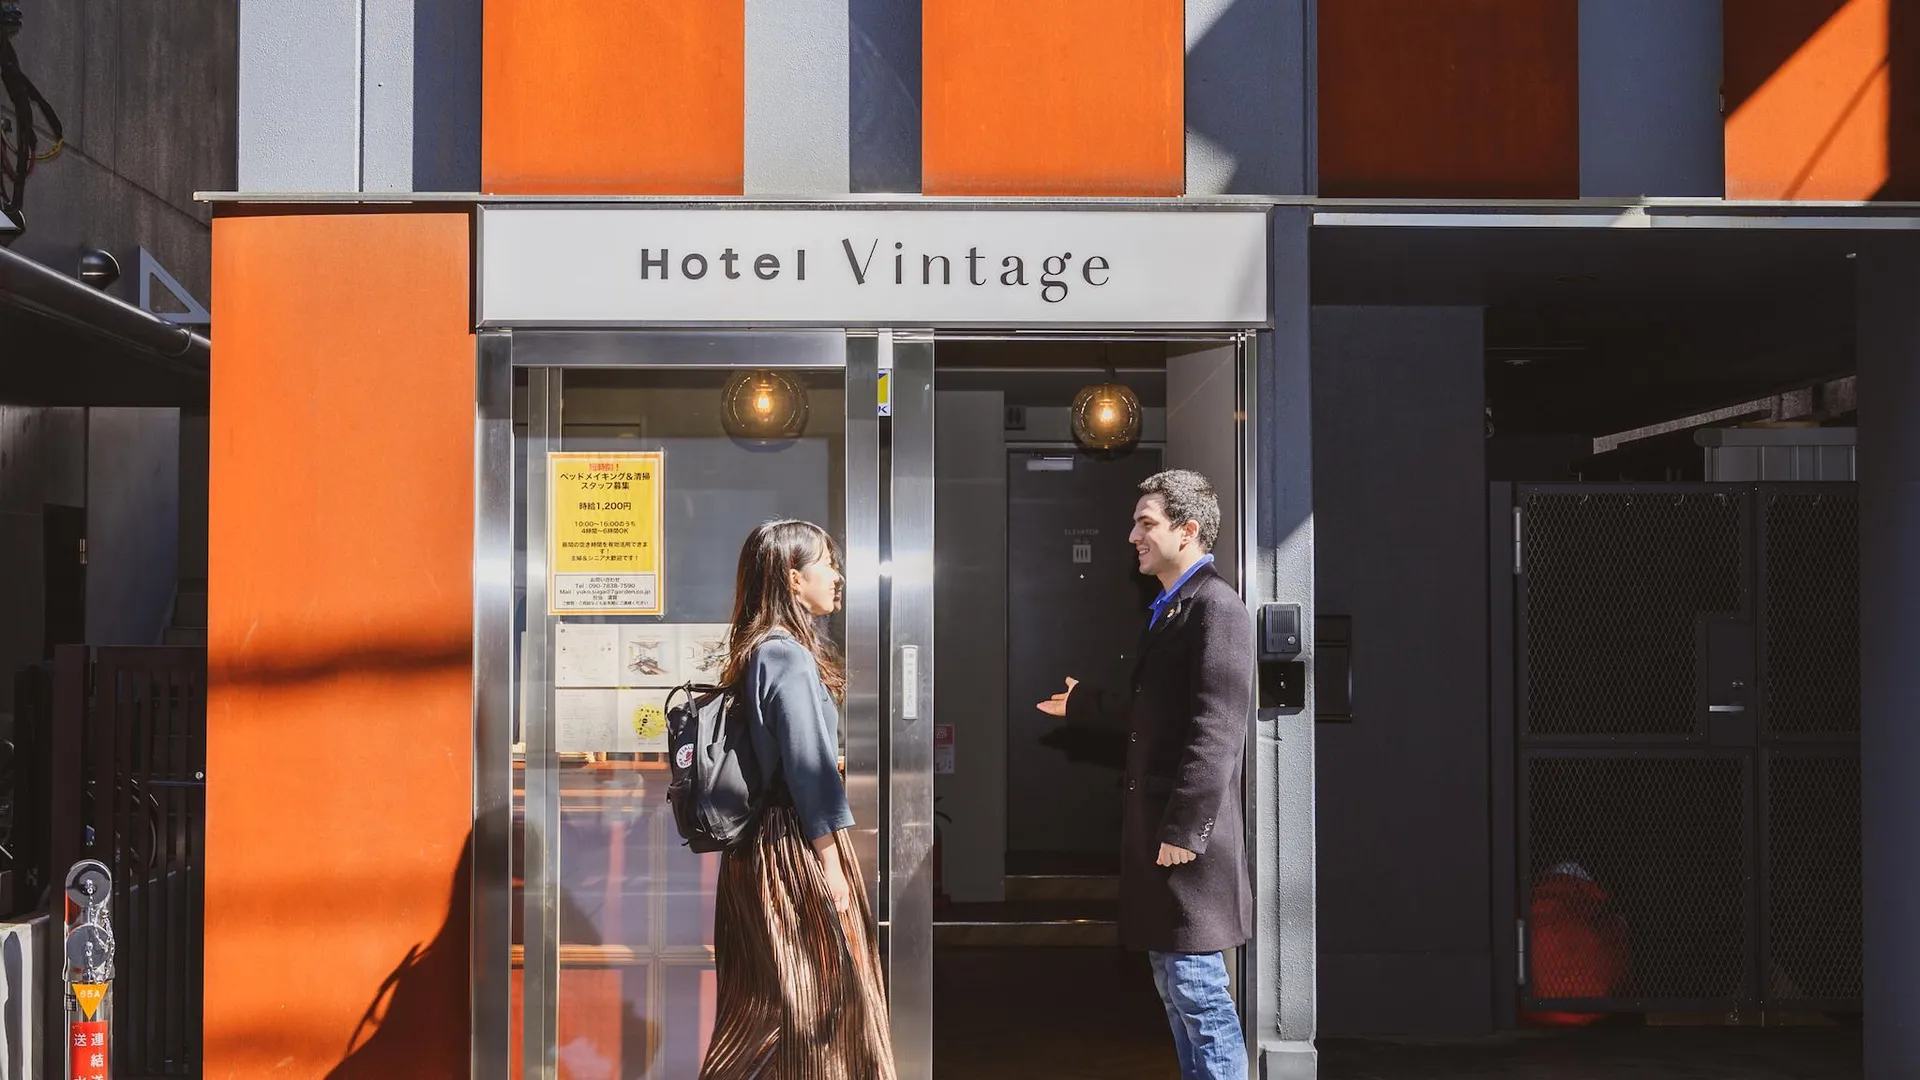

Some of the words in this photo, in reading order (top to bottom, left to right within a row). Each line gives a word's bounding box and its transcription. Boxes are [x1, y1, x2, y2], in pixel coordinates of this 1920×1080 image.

[640, 248, 806, 281] Hotel
[841, 237, 1112, 303] Vintage
[581, 481, 630, 490] スタッフ募集
[579, 501, 632, 511] 時給1,200円
